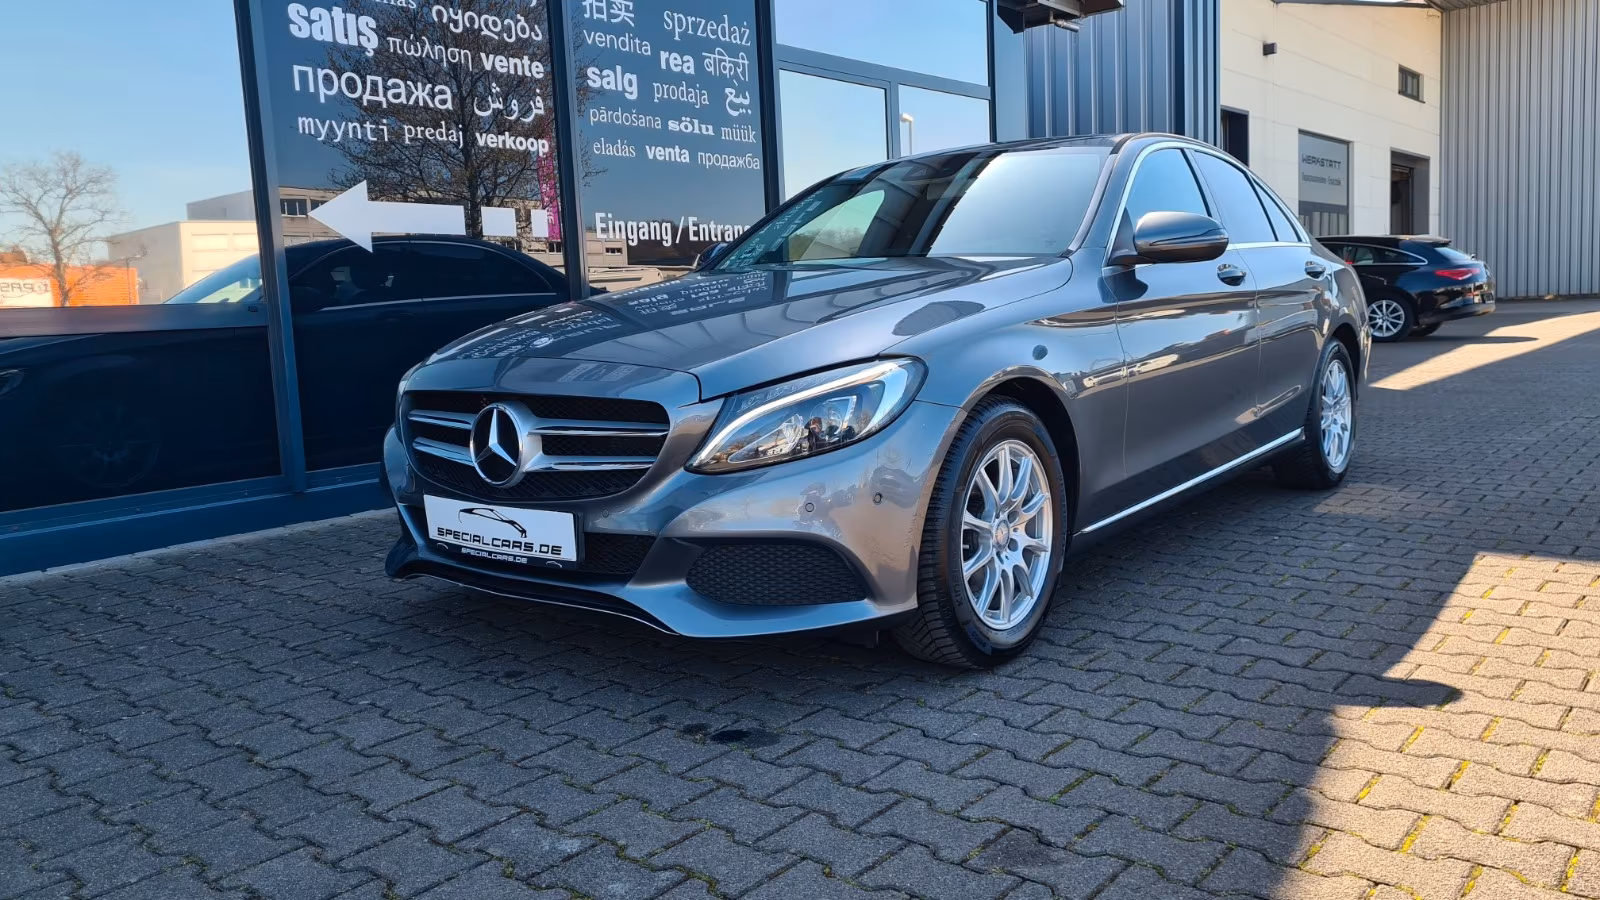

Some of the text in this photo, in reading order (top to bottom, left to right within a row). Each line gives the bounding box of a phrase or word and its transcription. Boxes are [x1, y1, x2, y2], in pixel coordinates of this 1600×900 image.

[287, 2, 379, 57] satış
[583, 29, 651, 56] vendita
[663, 9, 751, 46] sprzedaż
[387, 33, 473, 71] πώληση
[480, 51, 545, 79] vente
[660, 50, 696, 75] rea
[292, 64, 453, 111] продажа
[586, 65, 710, 109] salg prodaja
[724, 87, 752, 117] بيع
[297, 116, 550, 158] myynti predaj verkoop
[589, 106, 757, 144] pārdošana sölu müük
[593, 137, 690, 164] eladás venta
[697, 151, 761, 170] продажба
[595, 212, 672, 247] Eingang
[436, 526, 562, 556] SPECIALCARS.DE
[461, 547, 528, 565] SPECIALCARS.DE
